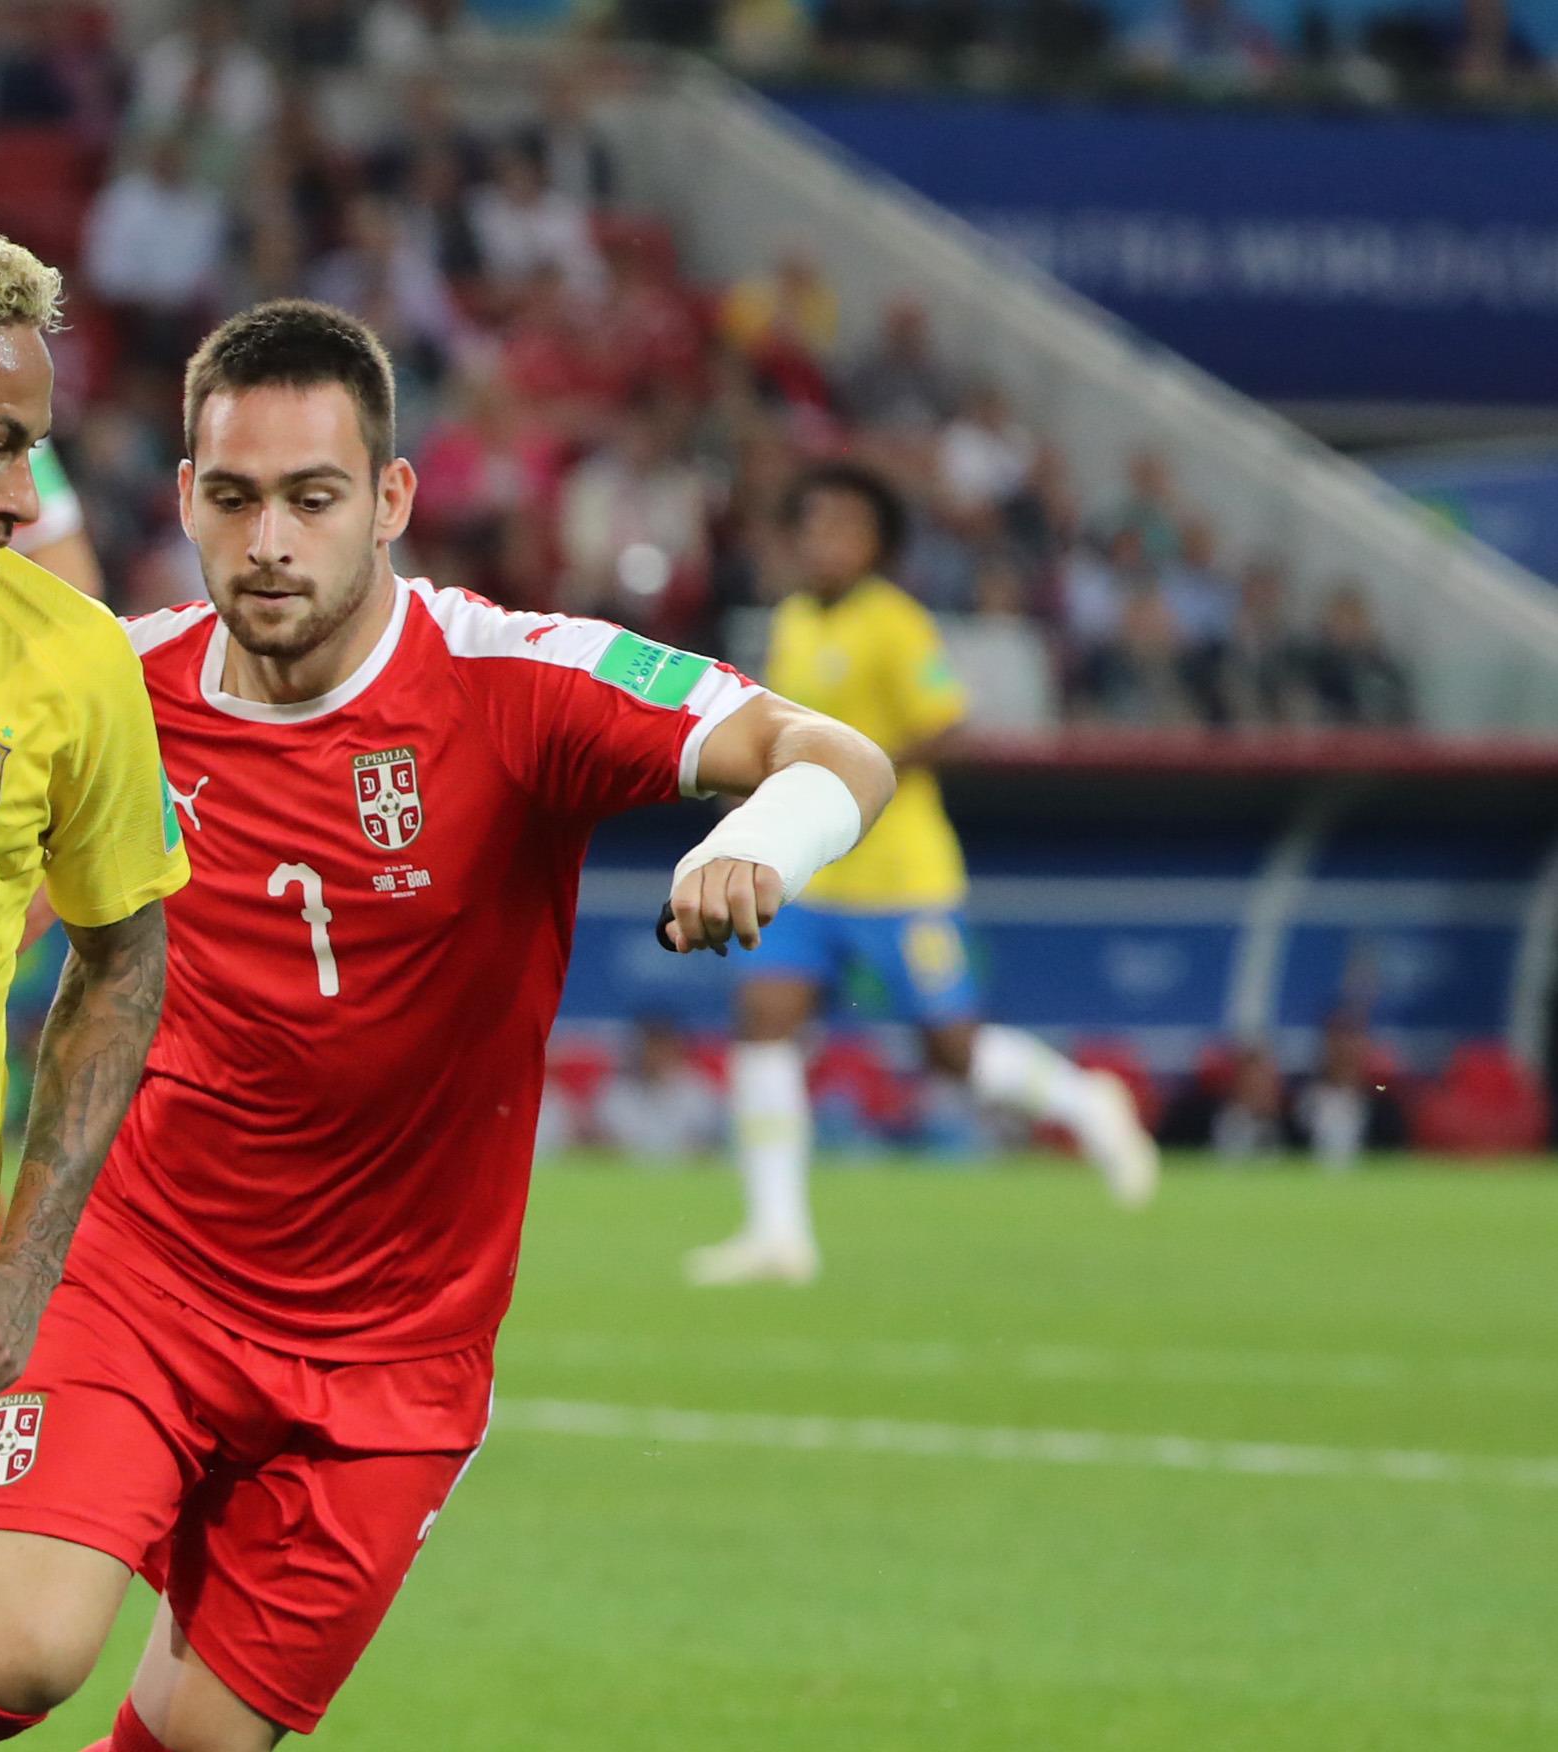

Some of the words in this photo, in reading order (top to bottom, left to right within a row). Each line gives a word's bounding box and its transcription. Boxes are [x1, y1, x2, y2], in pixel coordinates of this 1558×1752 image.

[621, 646, 653, 685] LIVIN
[372, 873, 396, 892] SRB
[406, 869, 431, 888] BRA
[267, 862, 340, 997] 7
